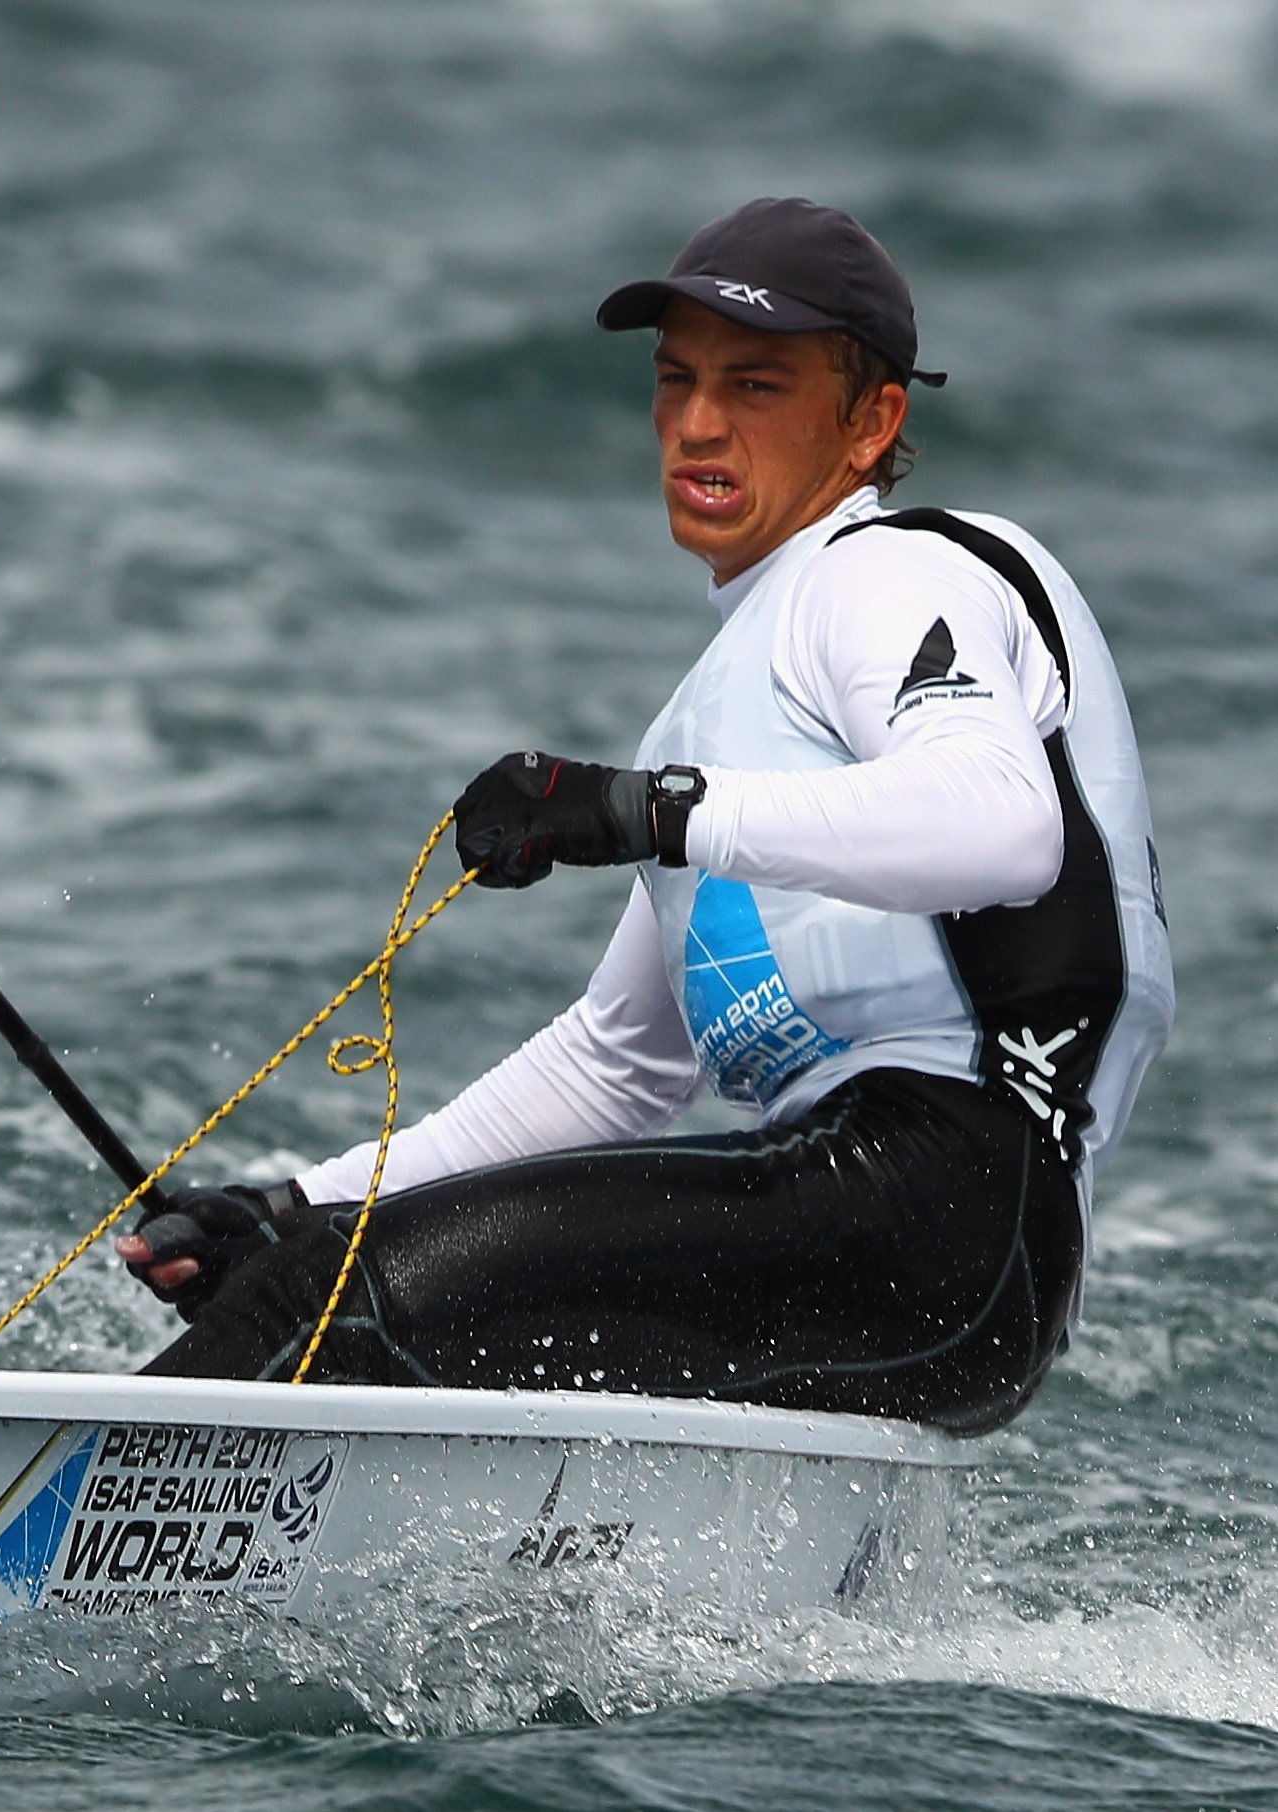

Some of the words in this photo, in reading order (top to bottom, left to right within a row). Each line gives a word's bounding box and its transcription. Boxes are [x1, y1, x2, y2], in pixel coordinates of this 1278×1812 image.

[726, 972, 785, 1029] 2011
[97, 1426, 215, 1468] PERTH
[212, 1429, 288, 1469] 2011
[81, 1475, 158, 1512] ISAF
[153, 1475, 272, 1513] SAILING
[63, 1519, 254, 1582] WORLD
